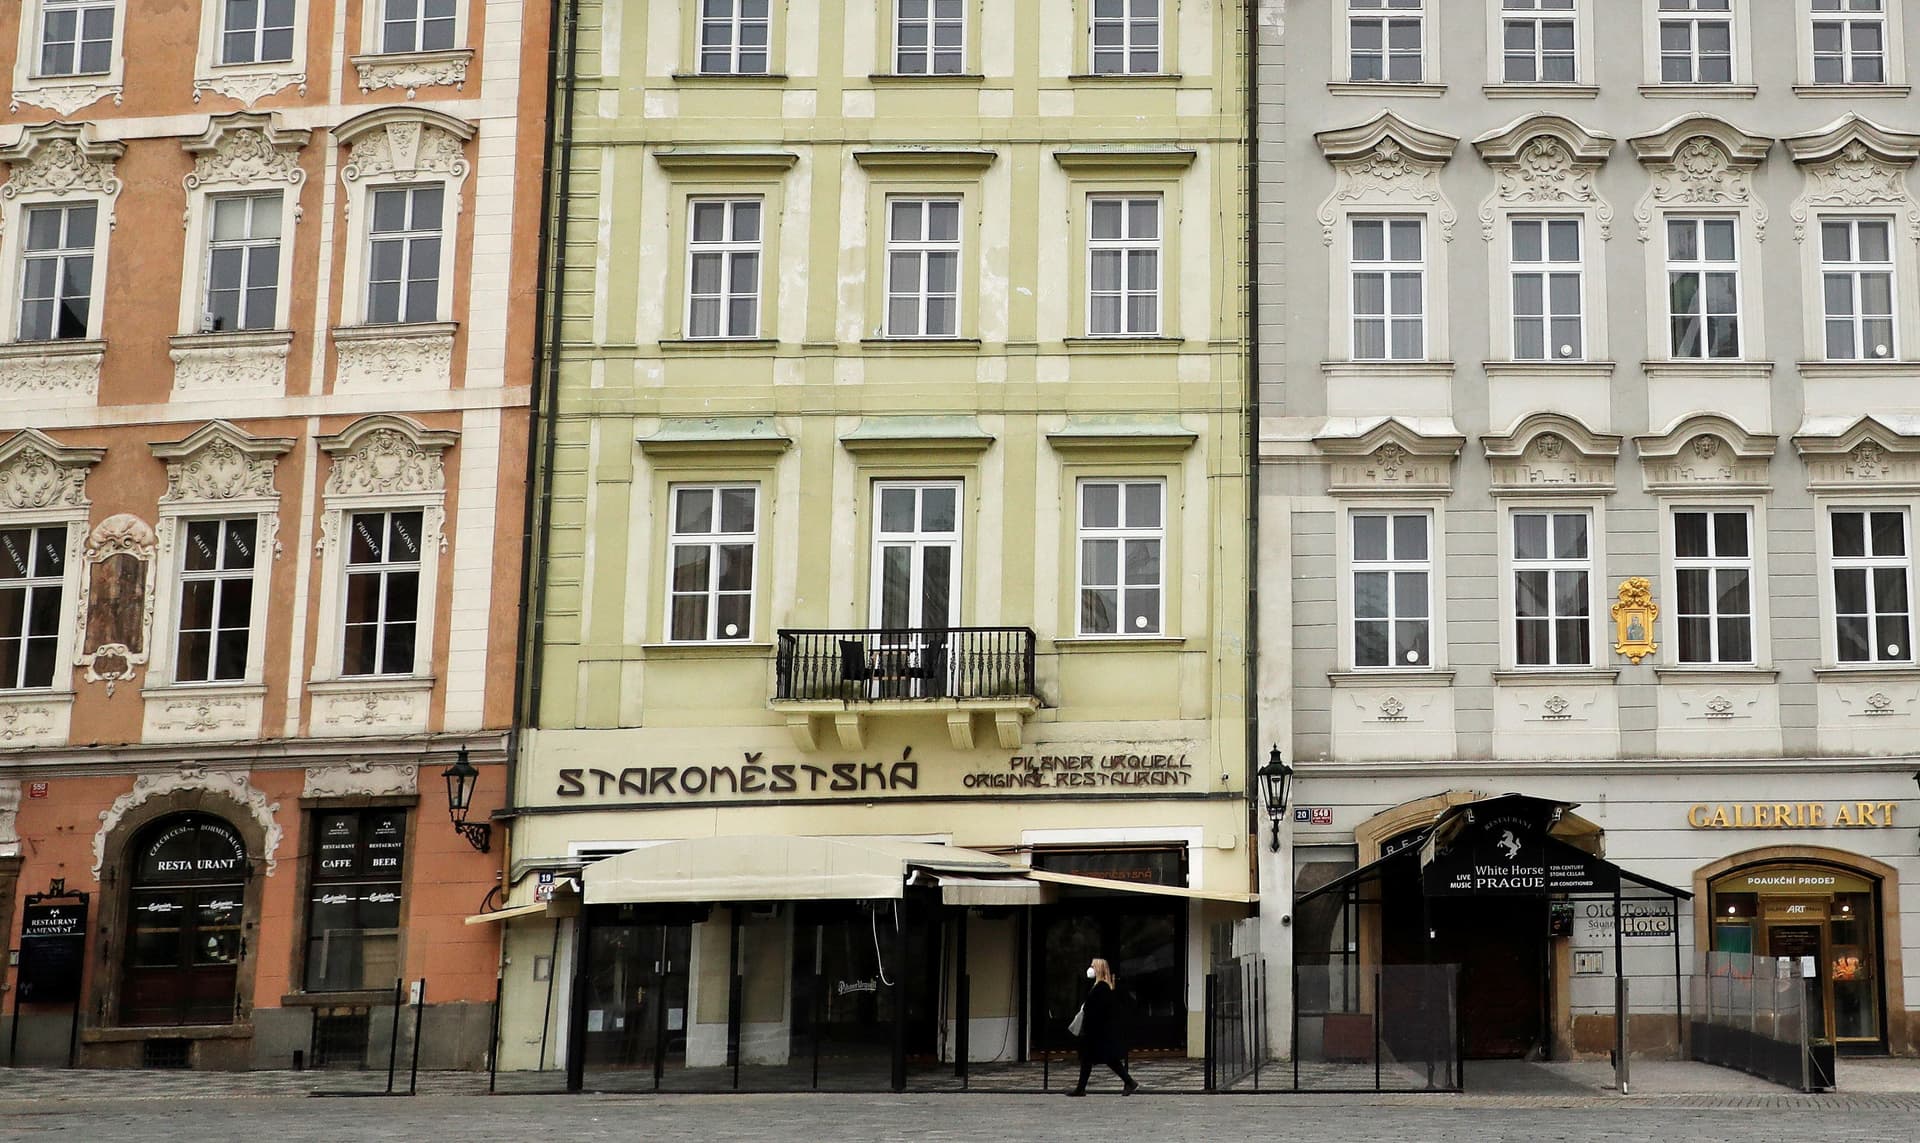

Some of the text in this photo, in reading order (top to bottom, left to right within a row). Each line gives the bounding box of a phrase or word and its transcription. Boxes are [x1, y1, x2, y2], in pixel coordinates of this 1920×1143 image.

[1010, 754, 1192, 771] PILSNER URQUELL
[557, 746, 918, 796] STAROMĚSTSKÁ
[963, 771, 1192, 788] ORIGINAL RESTAURANT
[1297, 811, 1307, 819] 20
[1688, 801, 1899, 828] GALERIE ART
[150, 834, 170, 856] CZECH
[322, 859, 352, 868] CAFFE
[373, 857, 397, 867] BEER
[1476, 864, 1544, 875] White Horse
[541, 874, 551, 882] 19
[1477, 877, 1545, 889] PRAGUE
[1748, 876, 1836, 885] POAUKČNÍ PRODEJ
[1786, 905, 1806, 914] ART
[31, 918, 78, 927] RESTAURANT
[1588, 919, 1616, 930] Squar
[1624, 917, 1671, 932] Hotel
